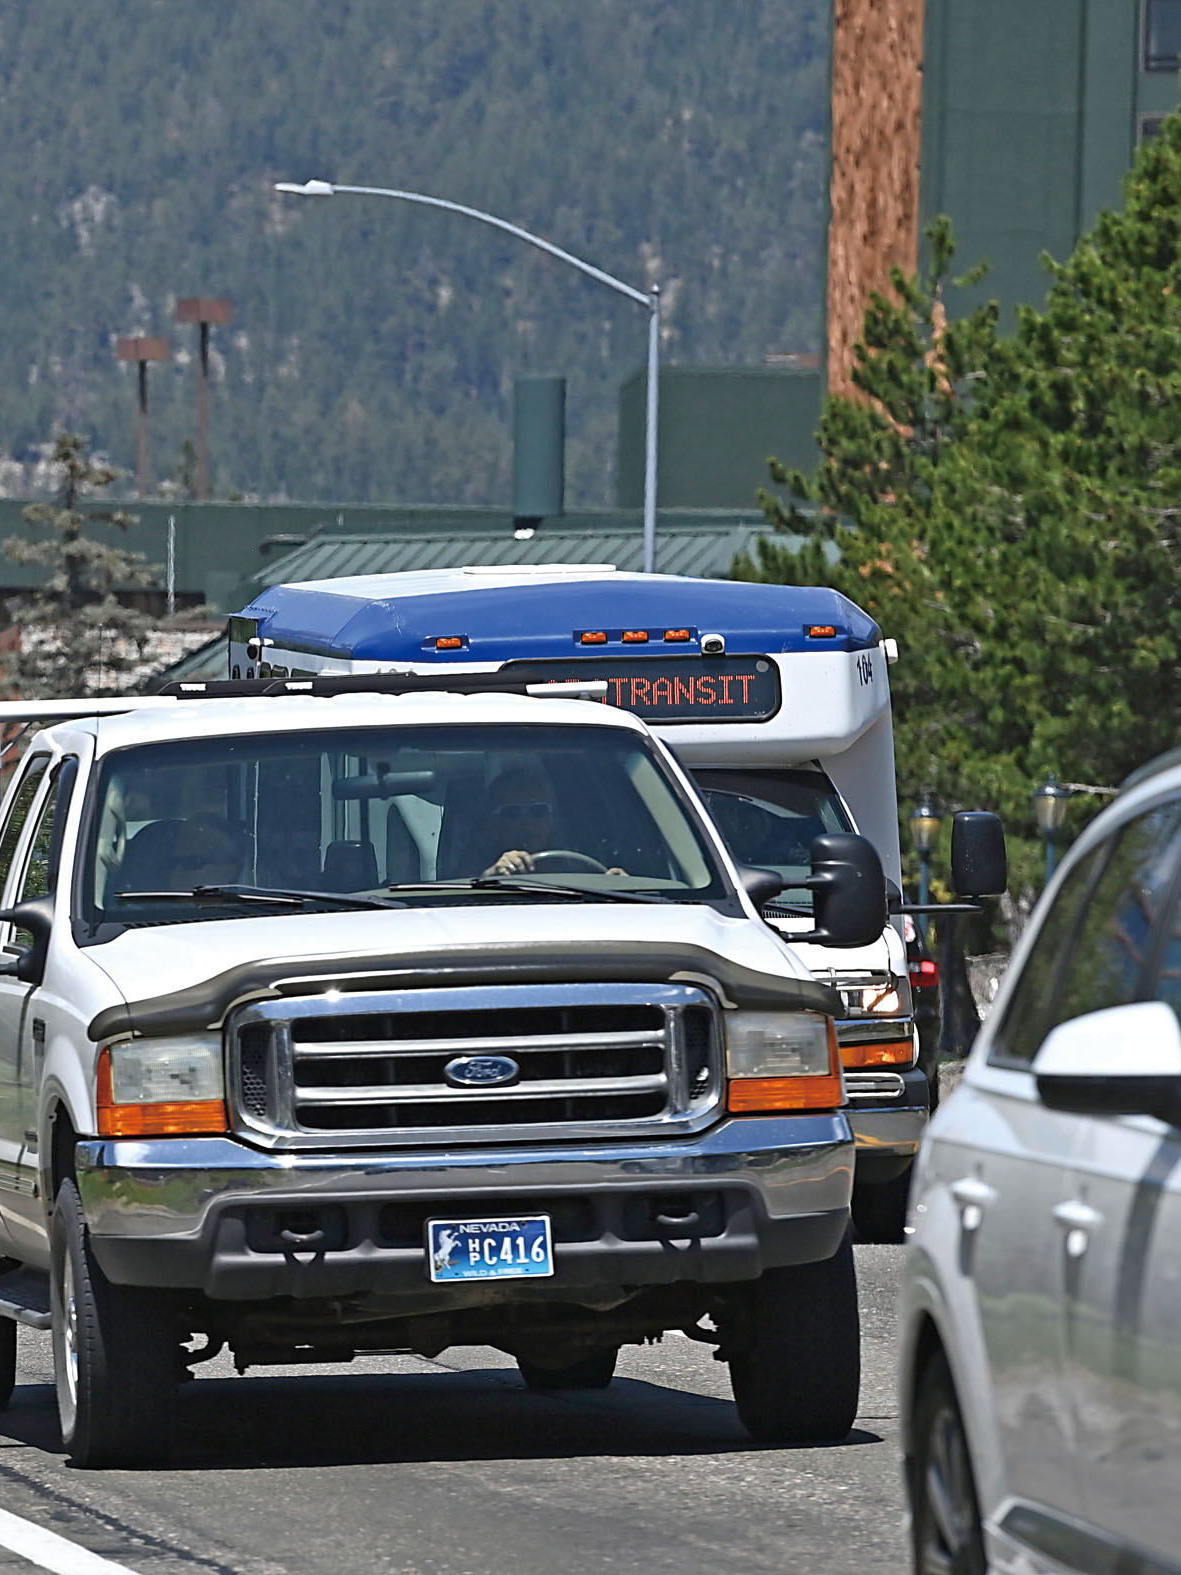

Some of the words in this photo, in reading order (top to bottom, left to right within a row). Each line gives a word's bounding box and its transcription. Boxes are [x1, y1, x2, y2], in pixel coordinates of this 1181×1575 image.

[857, 652, 873, 686] 104
[548, 675, 755, 706] TRANSIT
[459, 1222, 521, 1234] NEVADA
